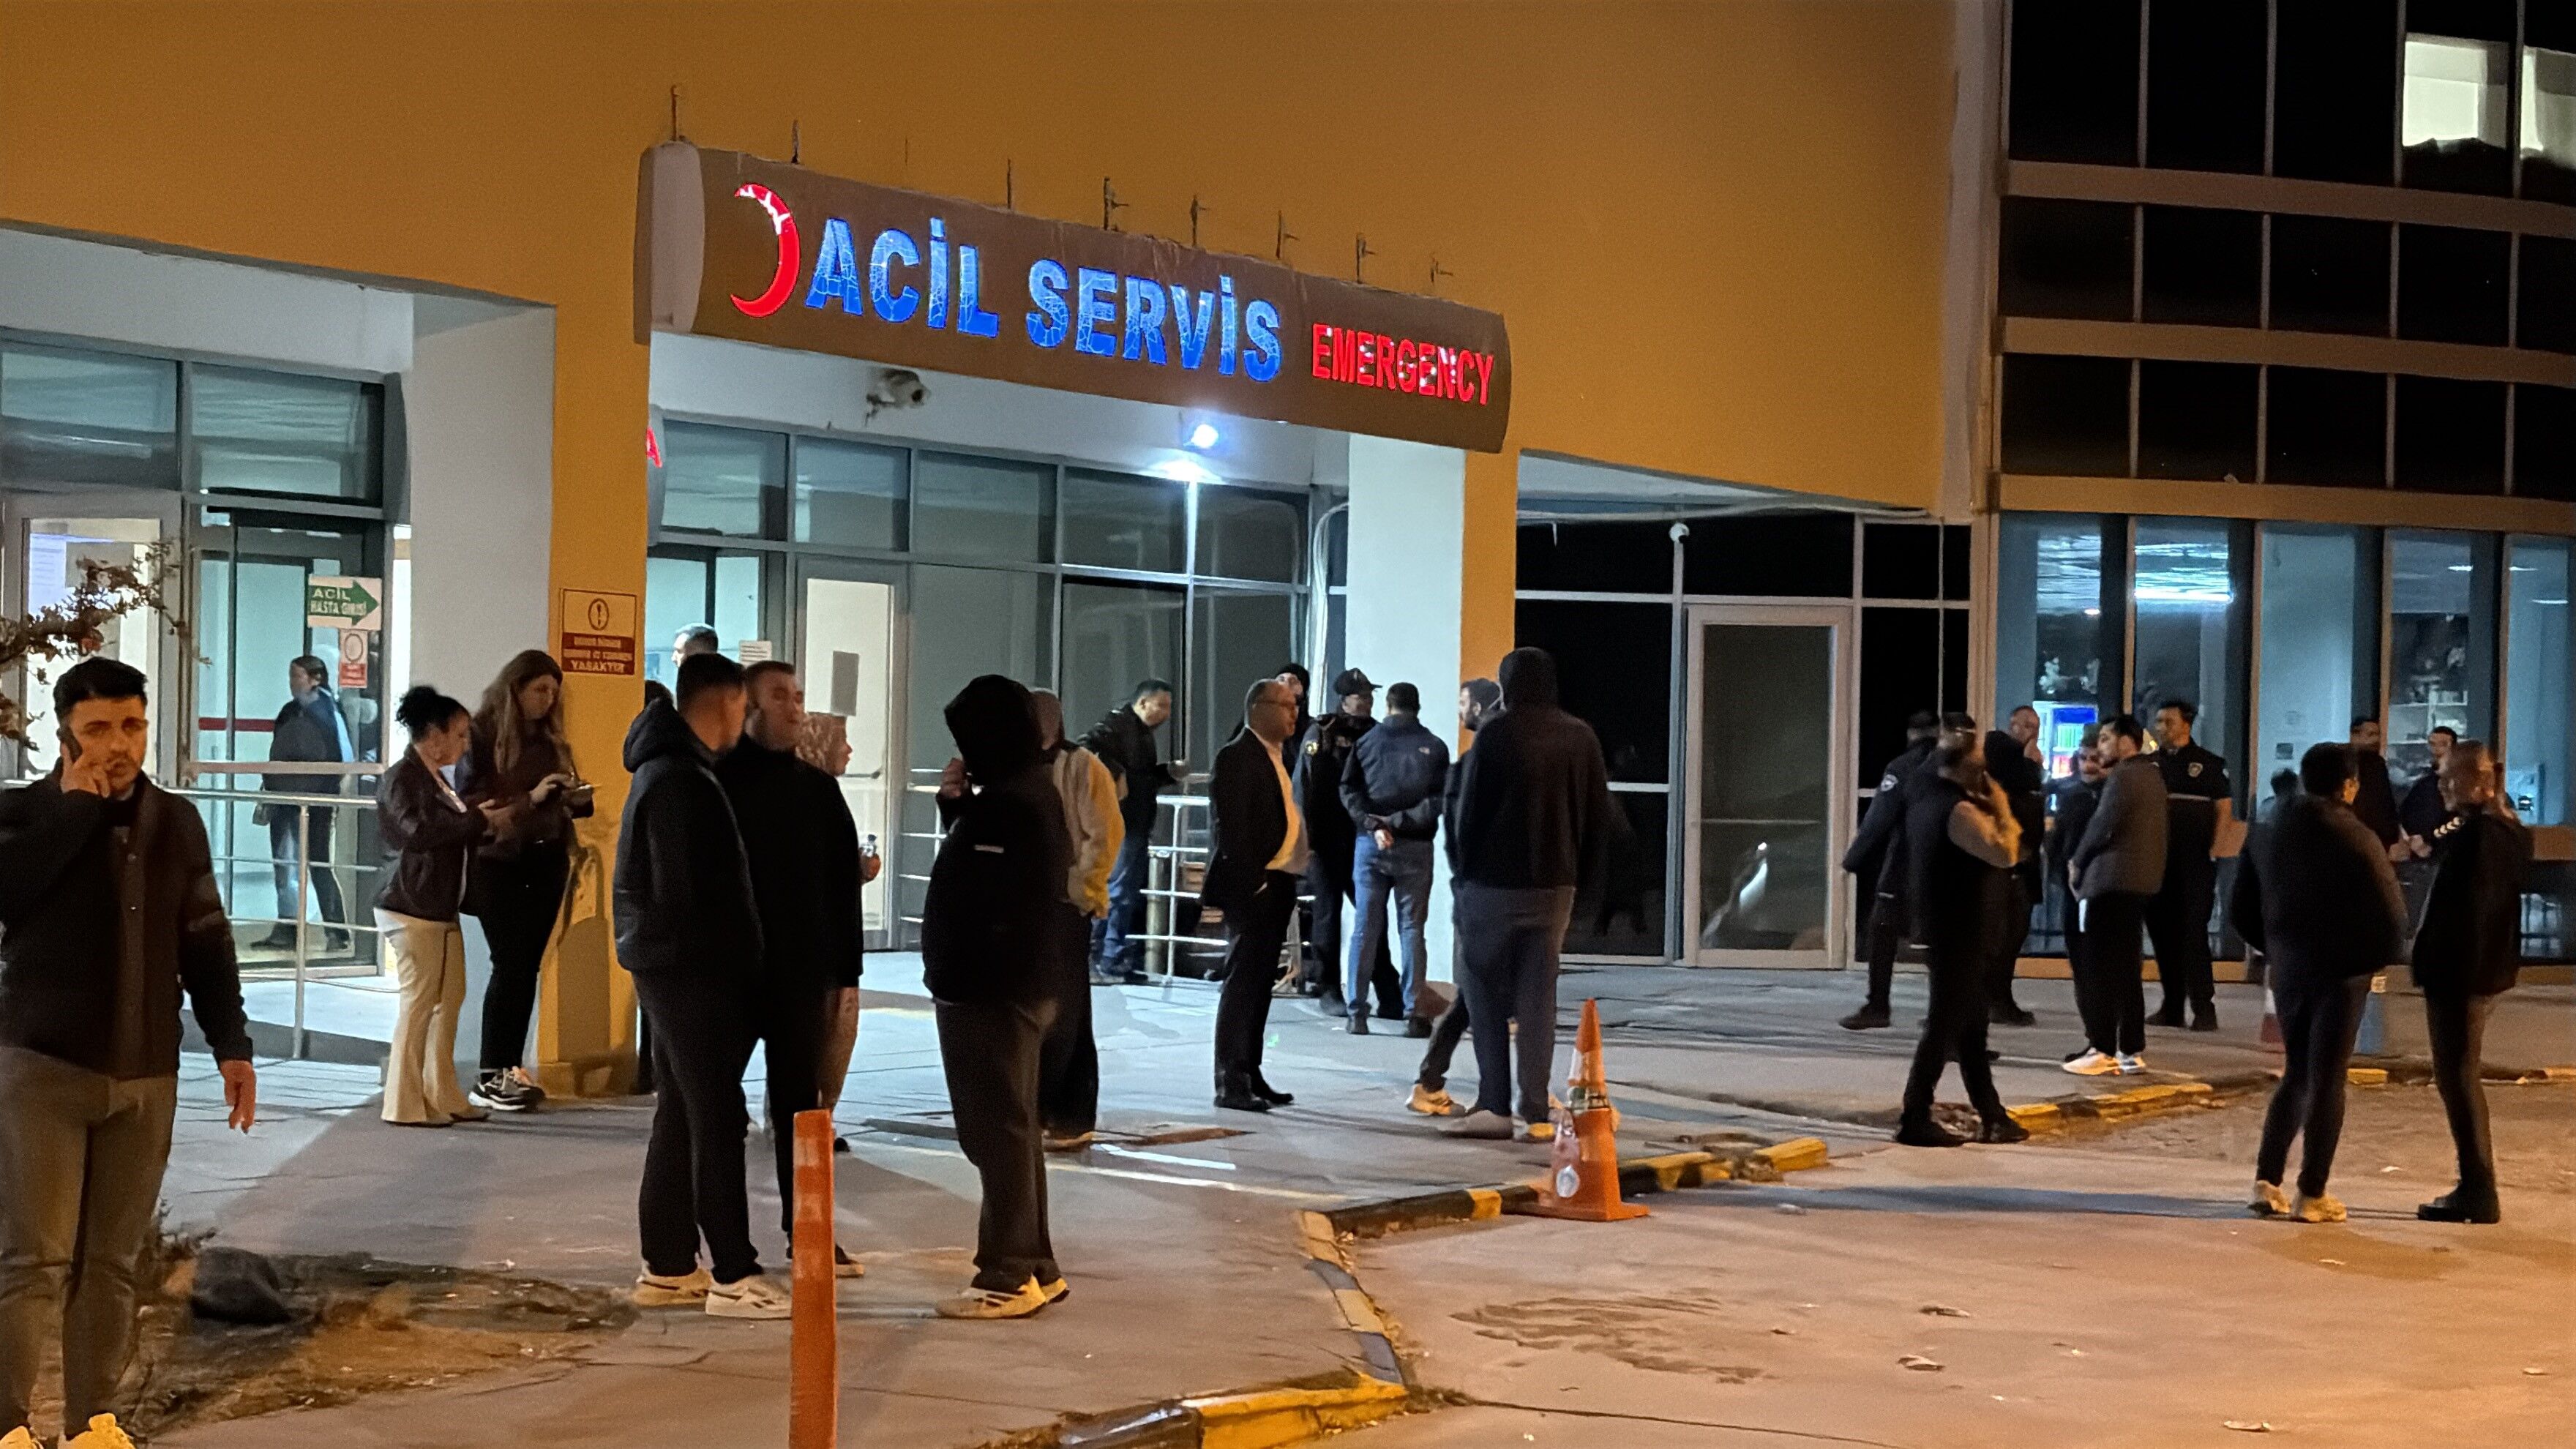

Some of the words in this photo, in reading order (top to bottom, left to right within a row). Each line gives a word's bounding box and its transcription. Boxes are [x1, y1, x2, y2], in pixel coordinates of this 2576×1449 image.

[804, 217, 1000, 338] ACİL
[1025, 259, 1284, 383] SERVİS
[1311, 322, 1494, 406] EMERGENCY
[312, 587, 351, 602] ACİL
